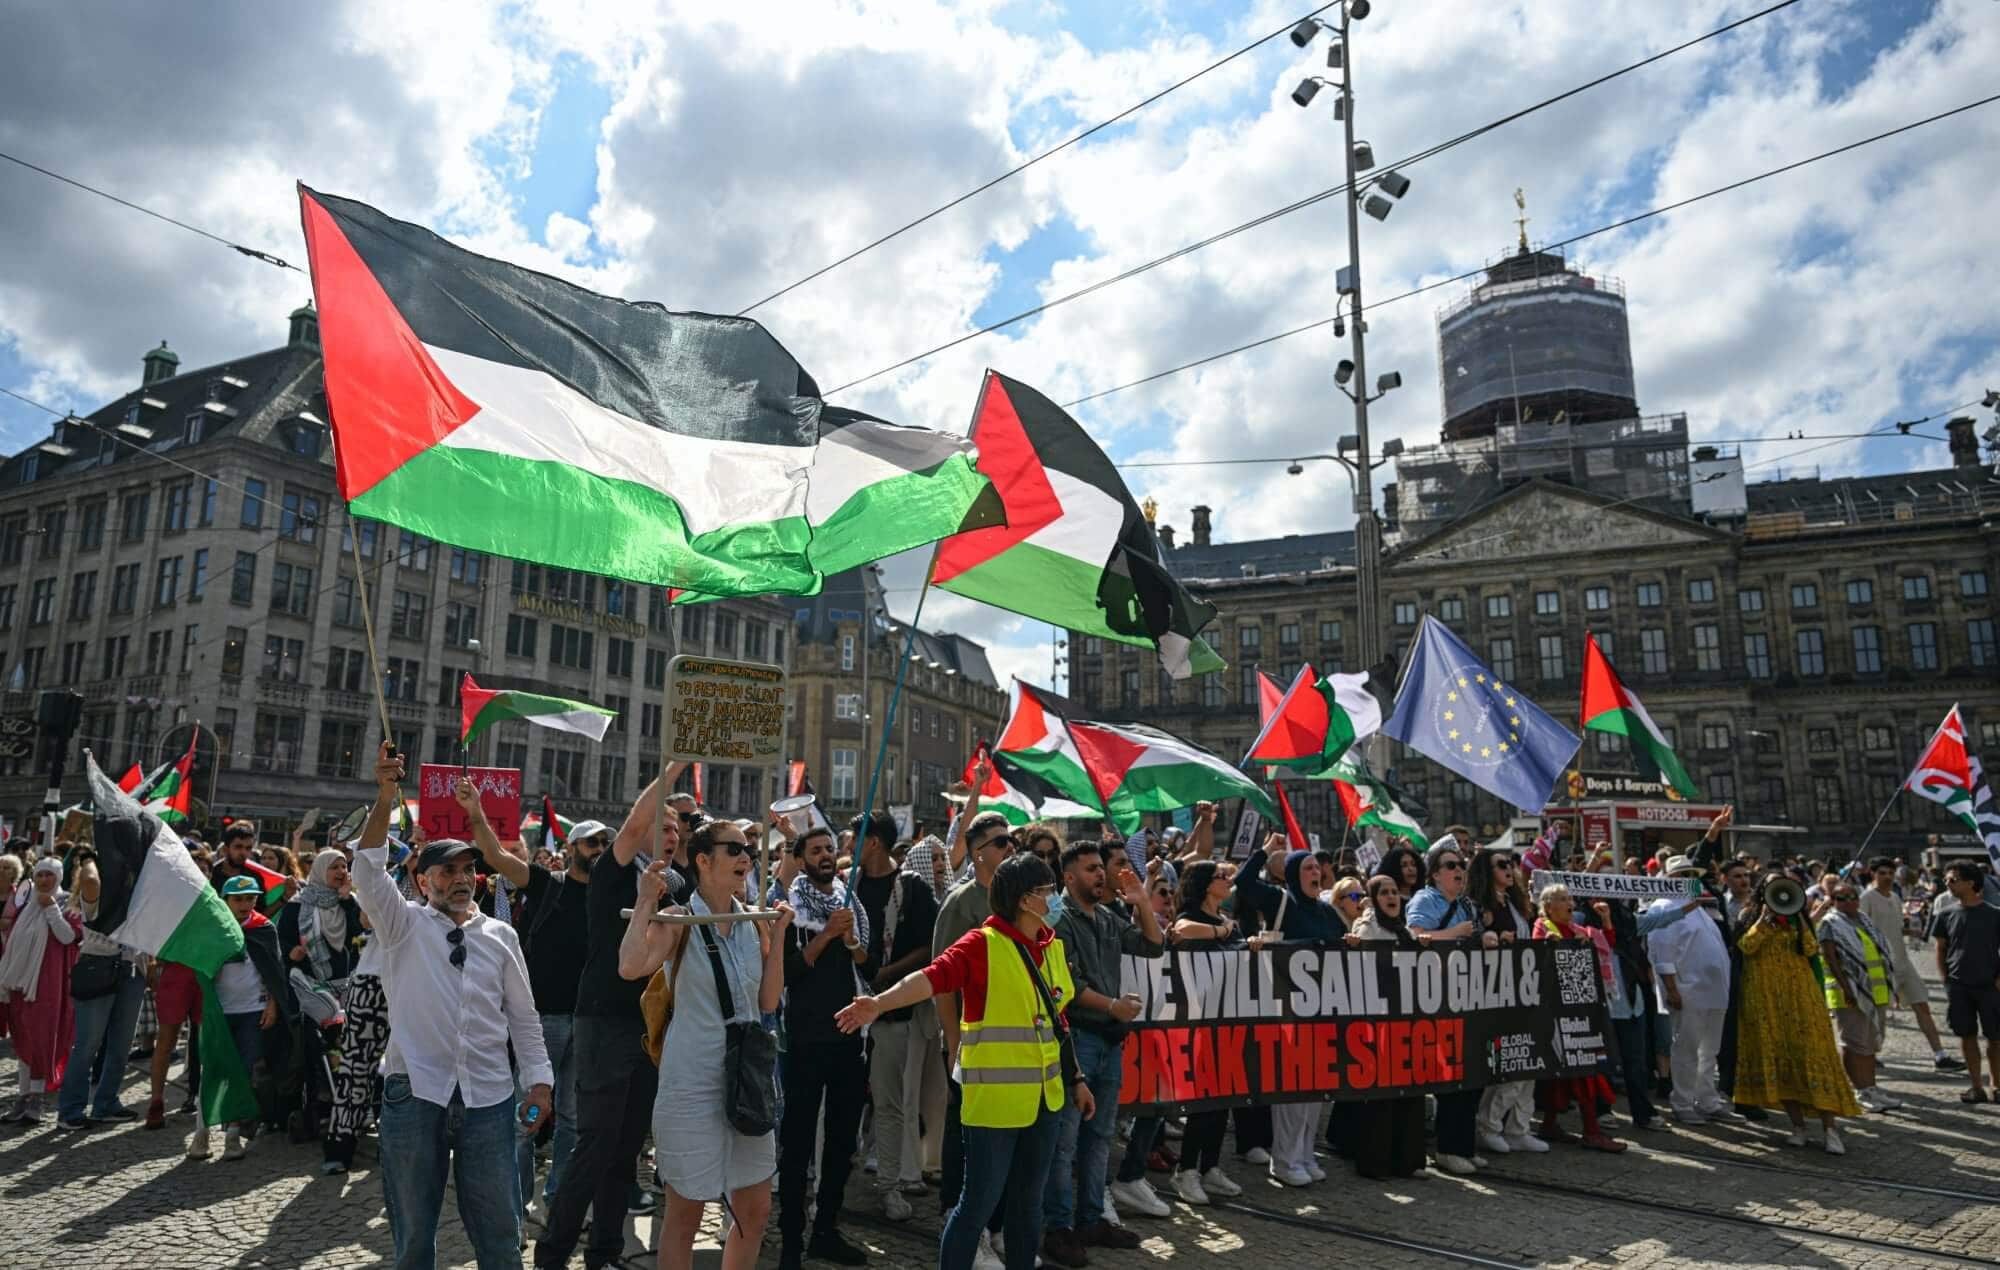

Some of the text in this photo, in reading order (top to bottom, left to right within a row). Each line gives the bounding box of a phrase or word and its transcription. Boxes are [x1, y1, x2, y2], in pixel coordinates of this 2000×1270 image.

[429, 775, 516, 798] BRAK
[1586, 777, 1613, 793] Dogs
[1615, 778, 1623, 791] &
[1636, 807, 1689, 821] HOTDOGS
[1562, 874, 1684, 893] FREE PALESTINE
[1178, 950, 1283, 1021] WILL
[1289, 949, 1388, 1016] SAIL
[1392, 950, 1442, 1015] TO
[1448, 949, 1515, 1013] GAZA
[1519, 948, 1540, 1006] &
[1559, 1015, 1591, 1033] Global
[1500, 1033, 1536, 1047] GLOBAL
[1562, 1031, 1605, 1050] Movement
[1117, 1018, 1464, 1104] BREAK THE SIEGE!
[1500, 1045, 1530, 1061] SUMUD
[1565, 1051, 1578, 1067] to
[1500, 1056, 1546, 1073] FLOTILLA
